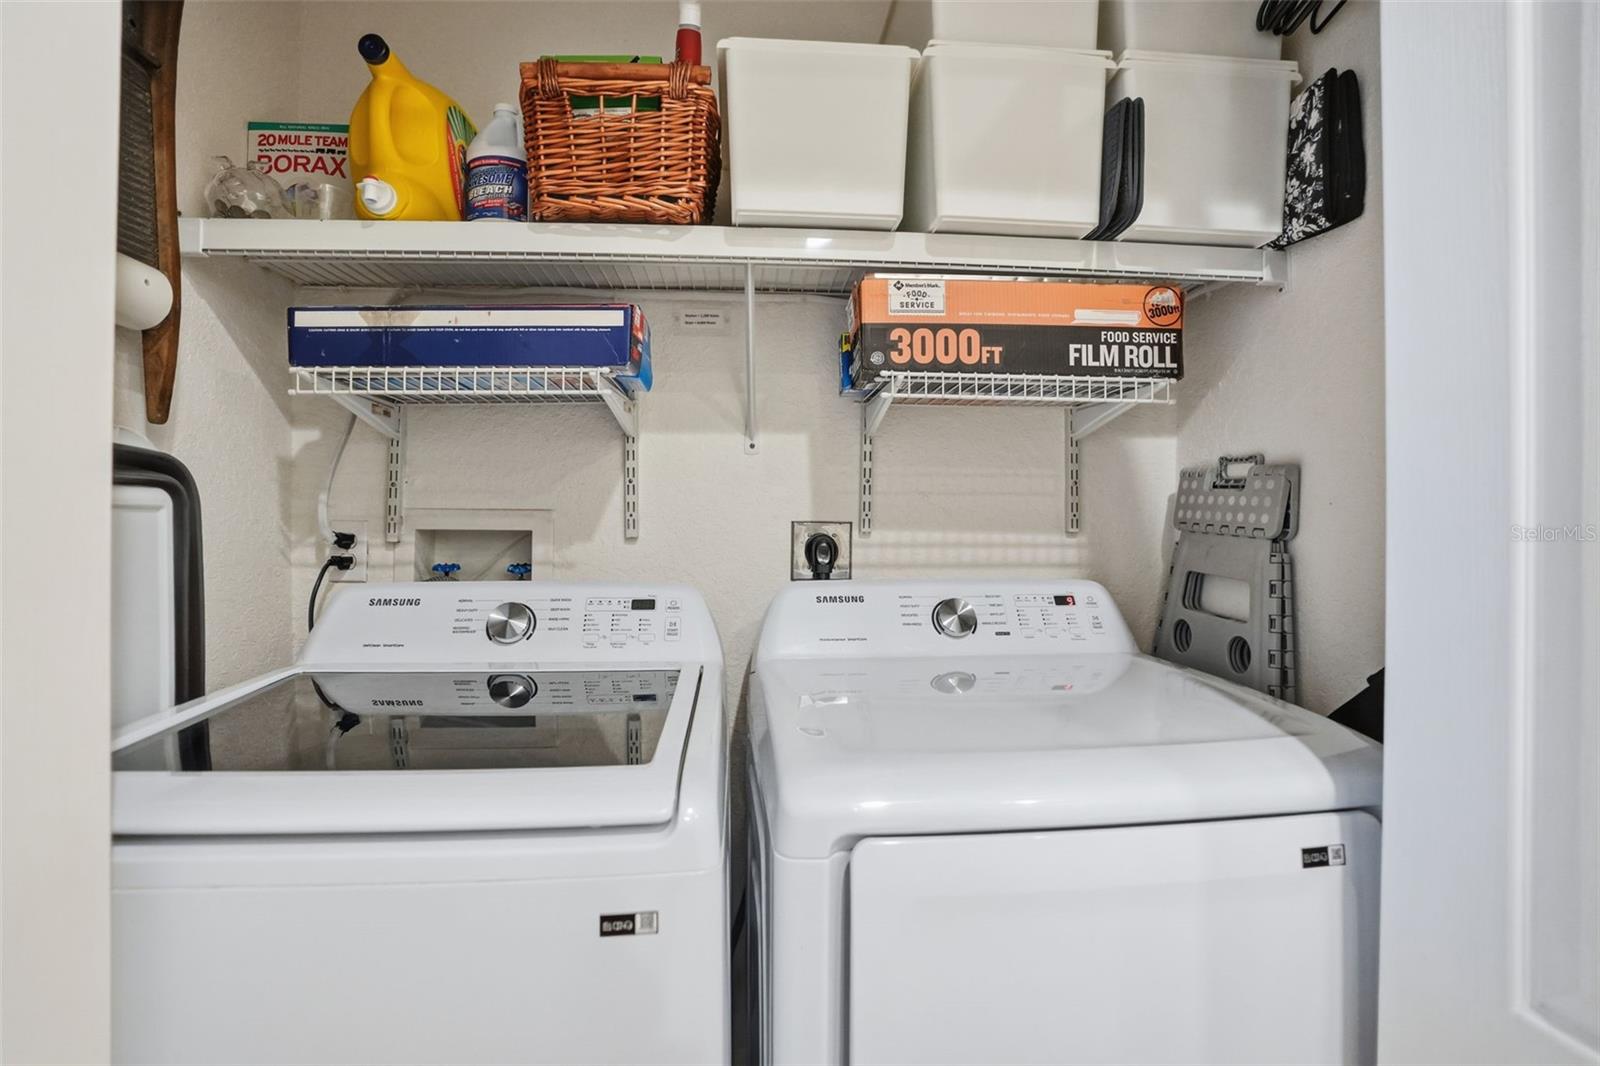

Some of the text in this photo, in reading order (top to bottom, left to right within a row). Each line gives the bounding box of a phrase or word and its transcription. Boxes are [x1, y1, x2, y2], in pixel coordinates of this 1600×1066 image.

[258, 134, 348, 148] 20 MULE TEAM
[257, 154, 347, 179] BORAX
[906, 290, 928, 298] FOOD
[899, 301, 935, 309] SERVICE
[1101, 331, 1177, 344] FOOD SERVICE
[1069, 343, 1178, 368] FILM ROLL
[368, 598, 421, 607] SAMSUNG
[815, 595, 865, 603] SAMSUNG
